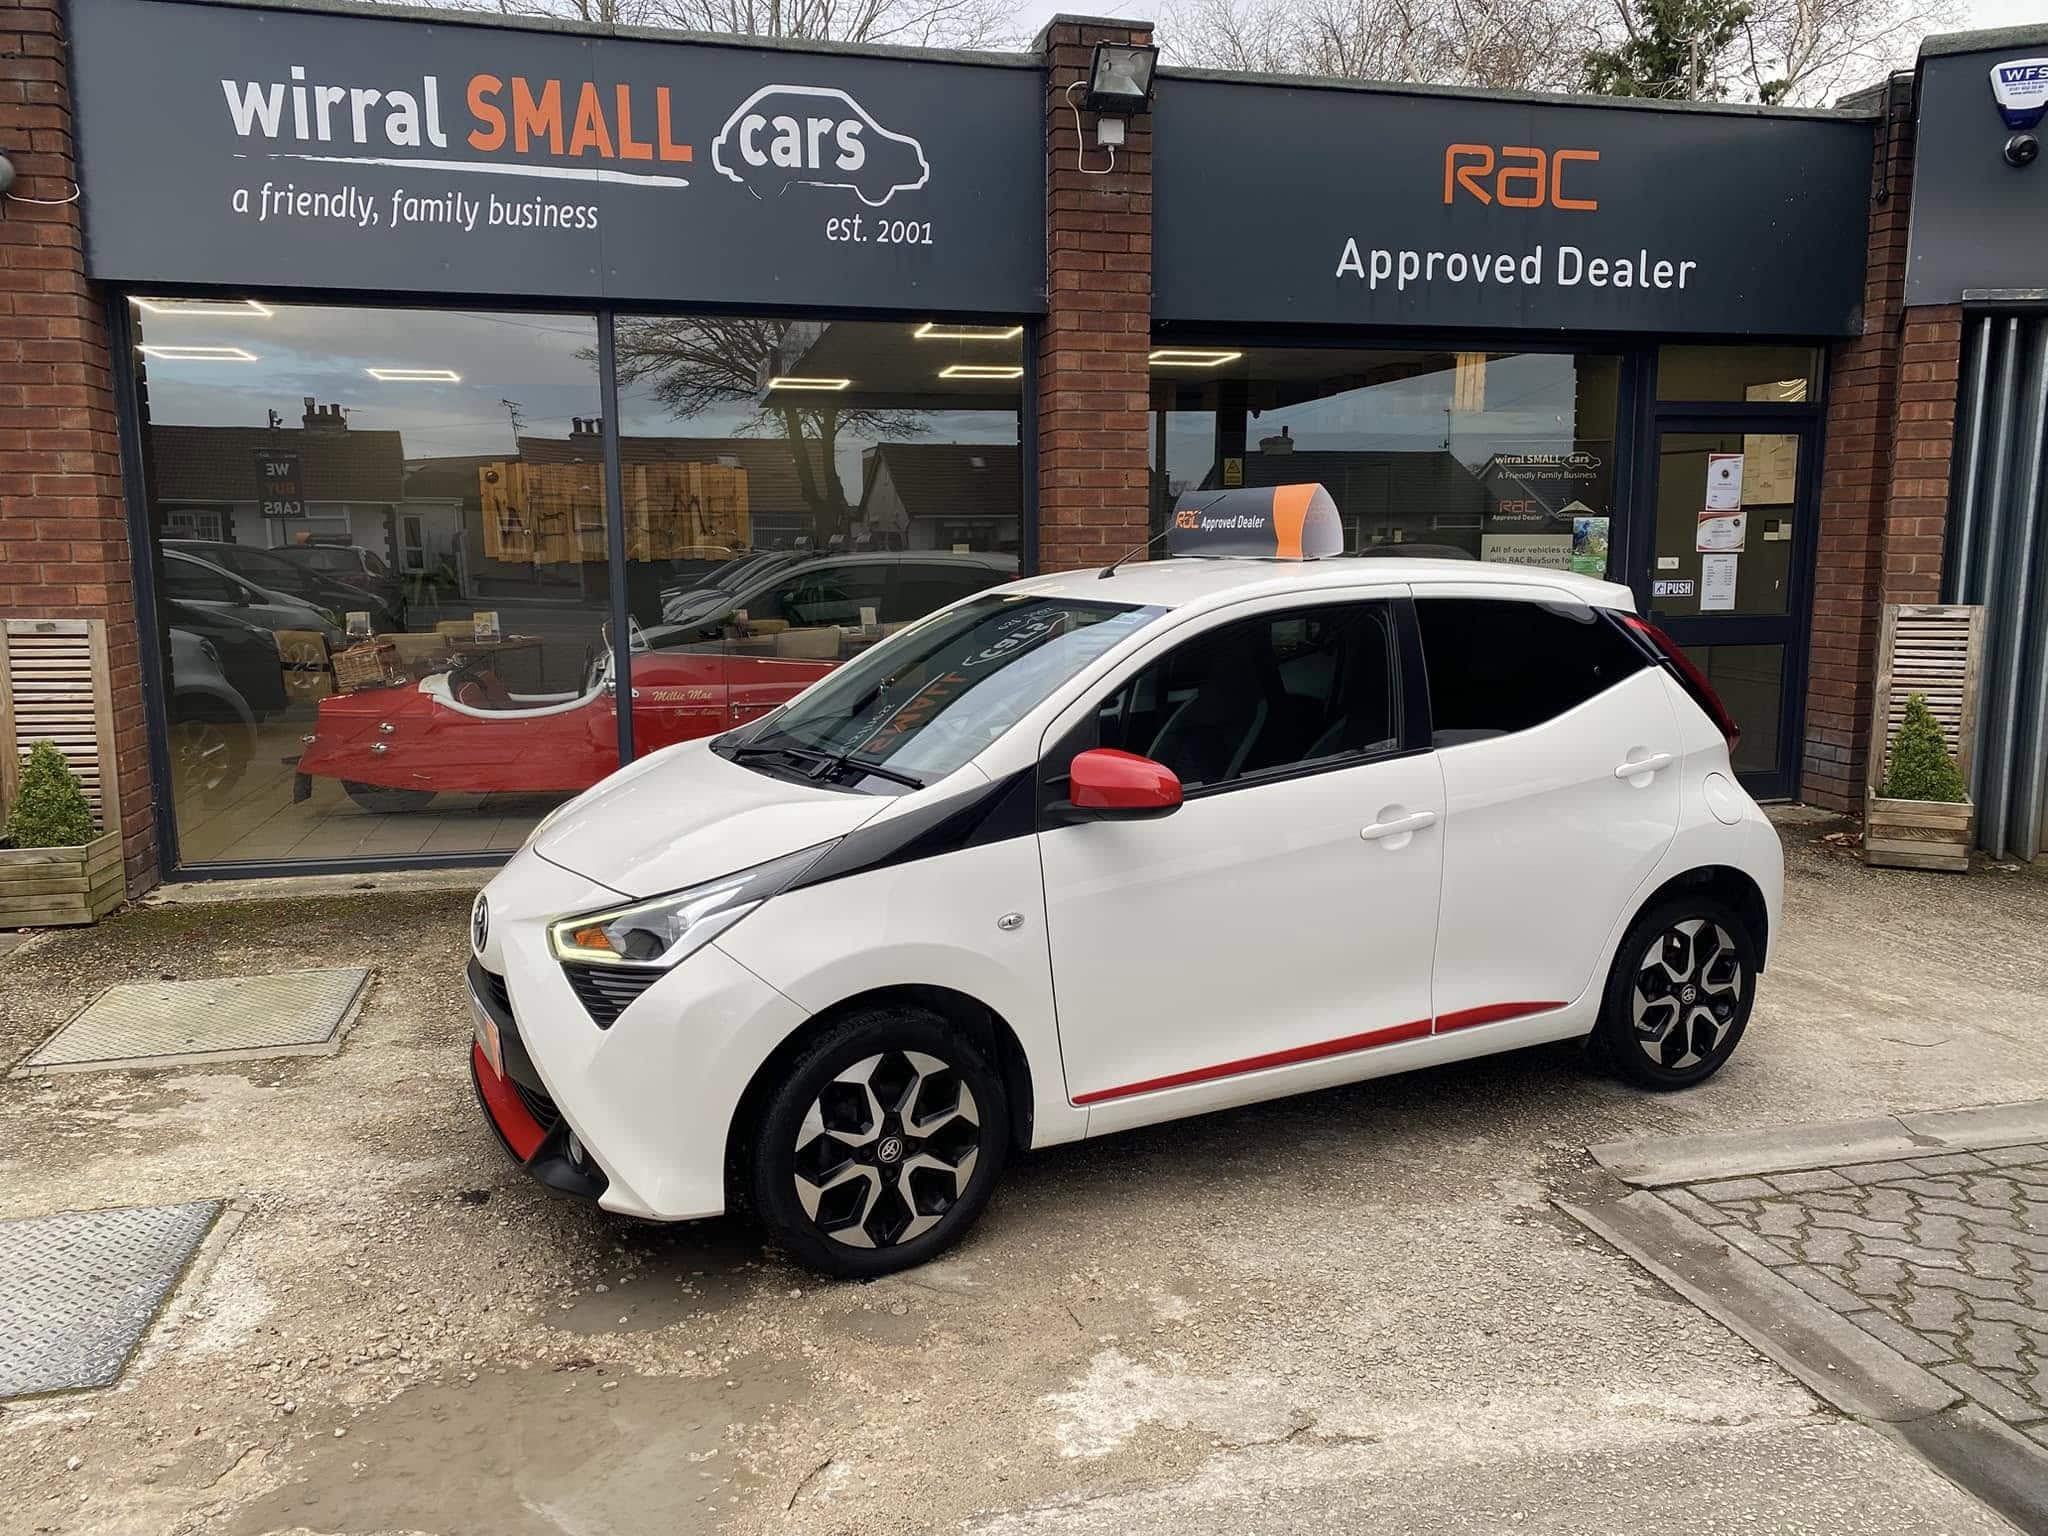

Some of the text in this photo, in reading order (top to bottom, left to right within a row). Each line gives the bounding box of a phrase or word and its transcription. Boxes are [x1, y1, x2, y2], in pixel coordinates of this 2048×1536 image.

[221, 66, 866, 171] wirral SMALL cars
[232, 182, 598, 232] a friendly, family business
[826, 214, 934, 244] est. 2001
[1336, 237, 1697, 291] Approved Dealer
[1495, 454, 1590, 464] wirral SMALL cars
[1505, 471, 1536, 480] Friendly
[1537, 471, 1562, 480] Family
[1563, 471, 1597, 479] Business
[1200, 515, 1237, 532] Approved
[1237, 515, 1266, 529] Dealer
[1526, 556, 1560, 565] BuySure
[1667, 582, 1691, 594] PUSH
[652, 689, 713, 702] Millie Mae
